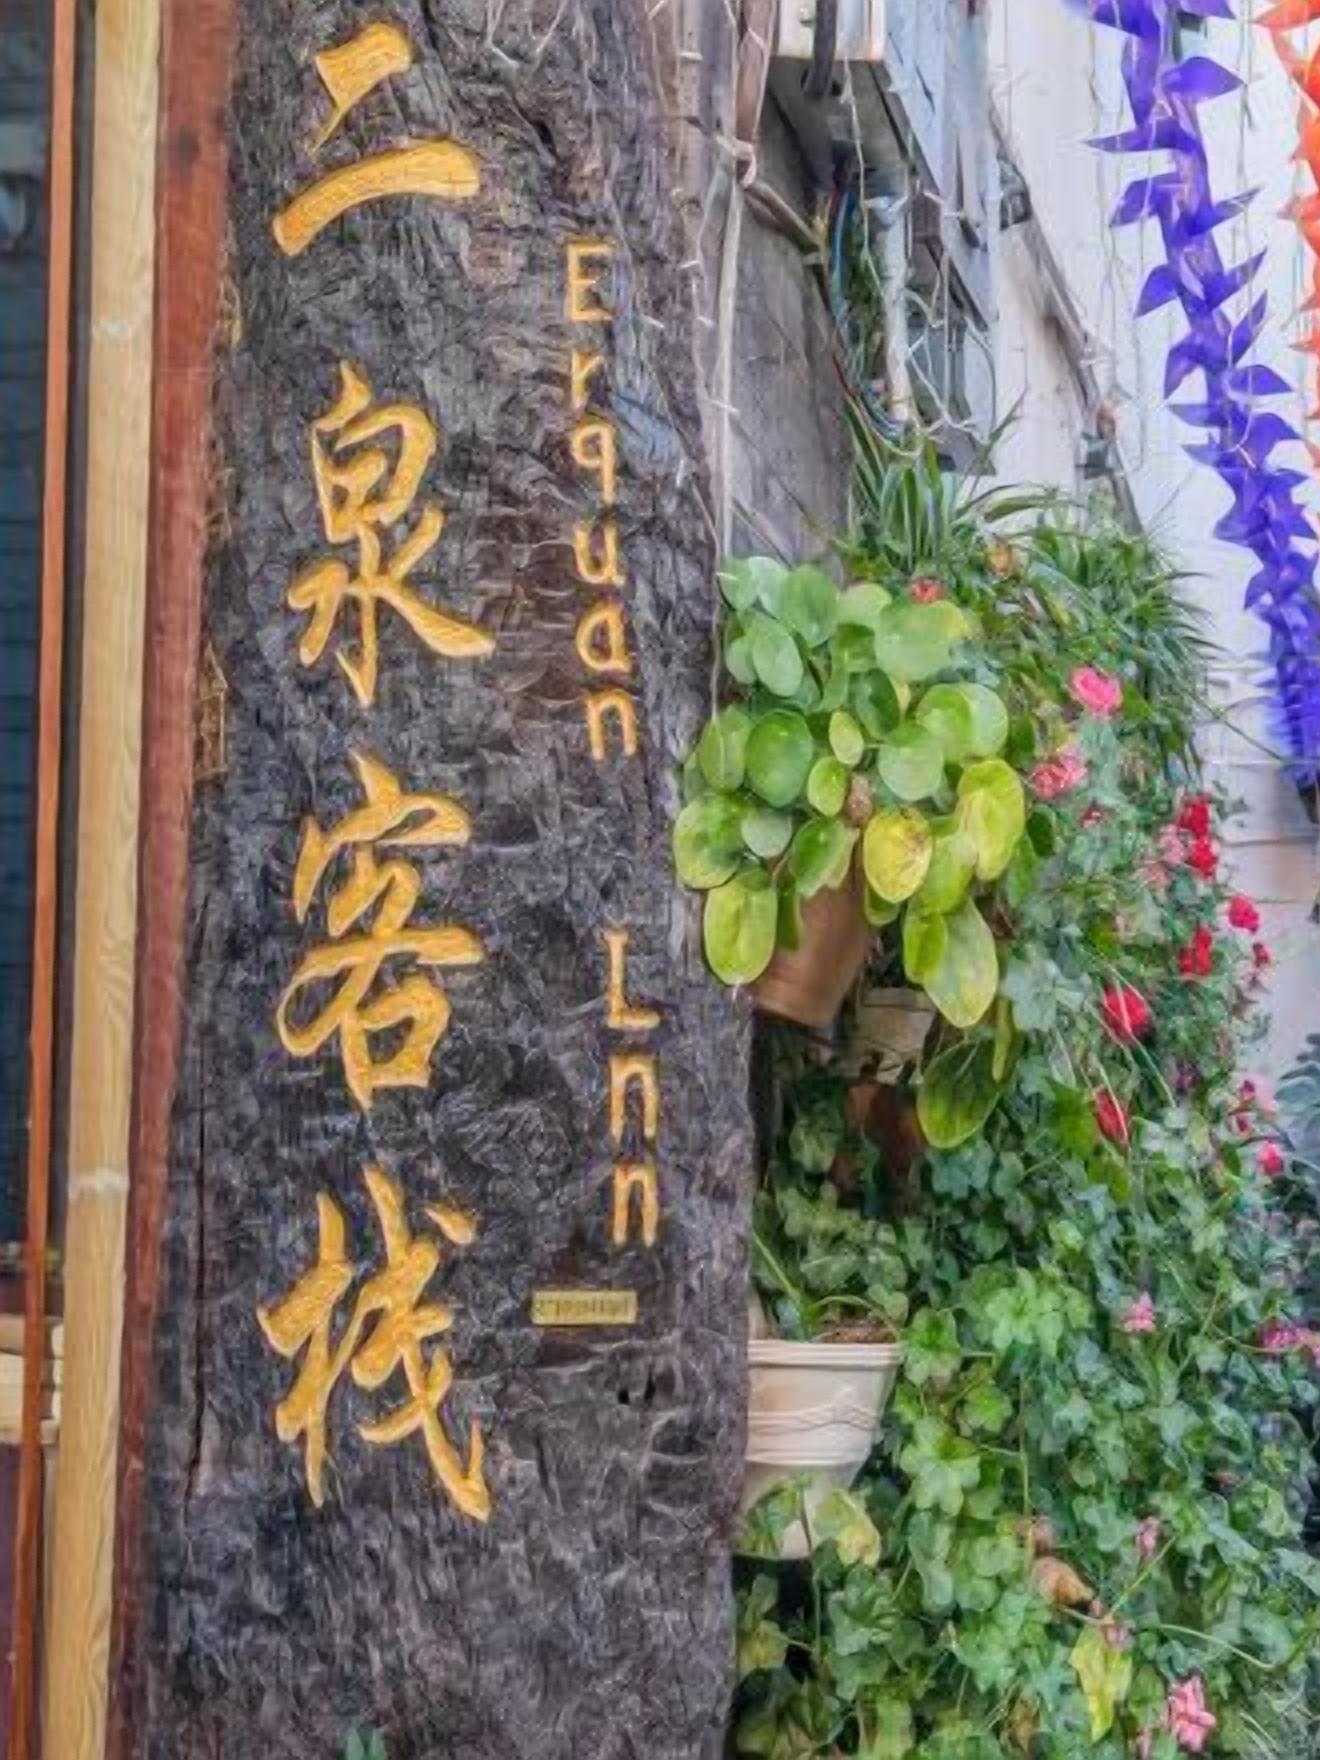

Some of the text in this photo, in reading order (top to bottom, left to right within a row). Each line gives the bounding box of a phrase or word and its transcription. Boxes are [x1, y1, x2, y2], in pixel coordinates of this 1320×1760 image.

[257, 22, 494, 1523] 二泉客栈
[566, 240, 638, 760] Erquan
